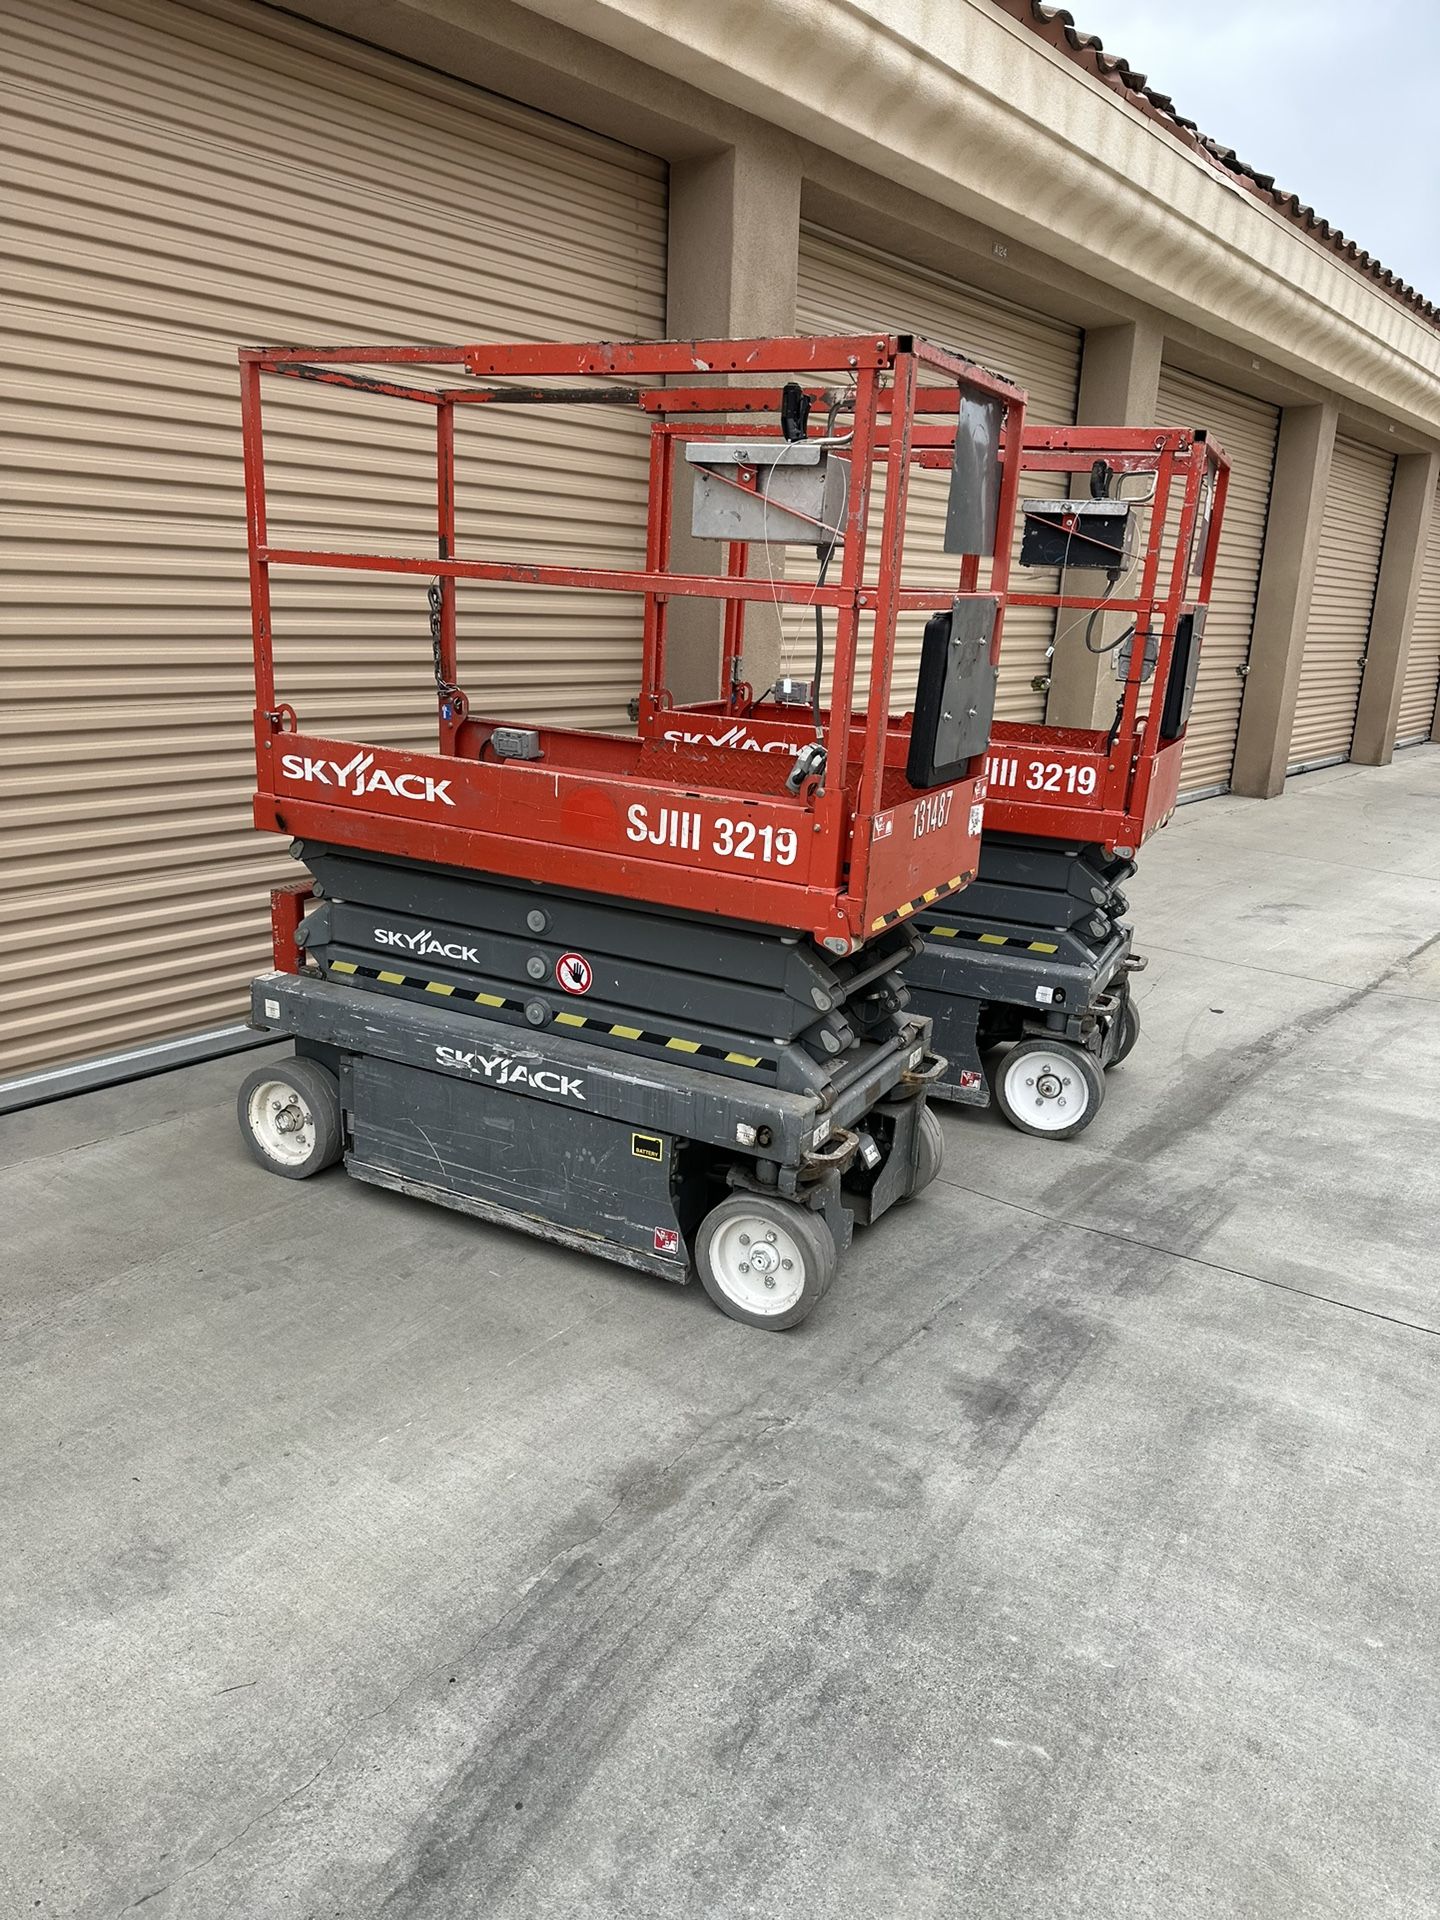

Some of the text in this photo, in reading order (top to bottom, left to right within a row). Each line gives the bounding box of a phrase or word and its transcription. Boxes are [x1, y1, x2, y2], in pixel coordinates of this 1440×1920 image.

[281, 750, 457, 806] SKYJACK
[1026, 761, 1097, 795] 3219
[626, 803, 798, 866] SJIII 3219
[913, 790, 953, 839] 131487
[374, 928, 480, 964] SKYJACK
[435, 1046, 586, 1100] SKYJACK
[635, 1147, 659, 1157] BATTERY
